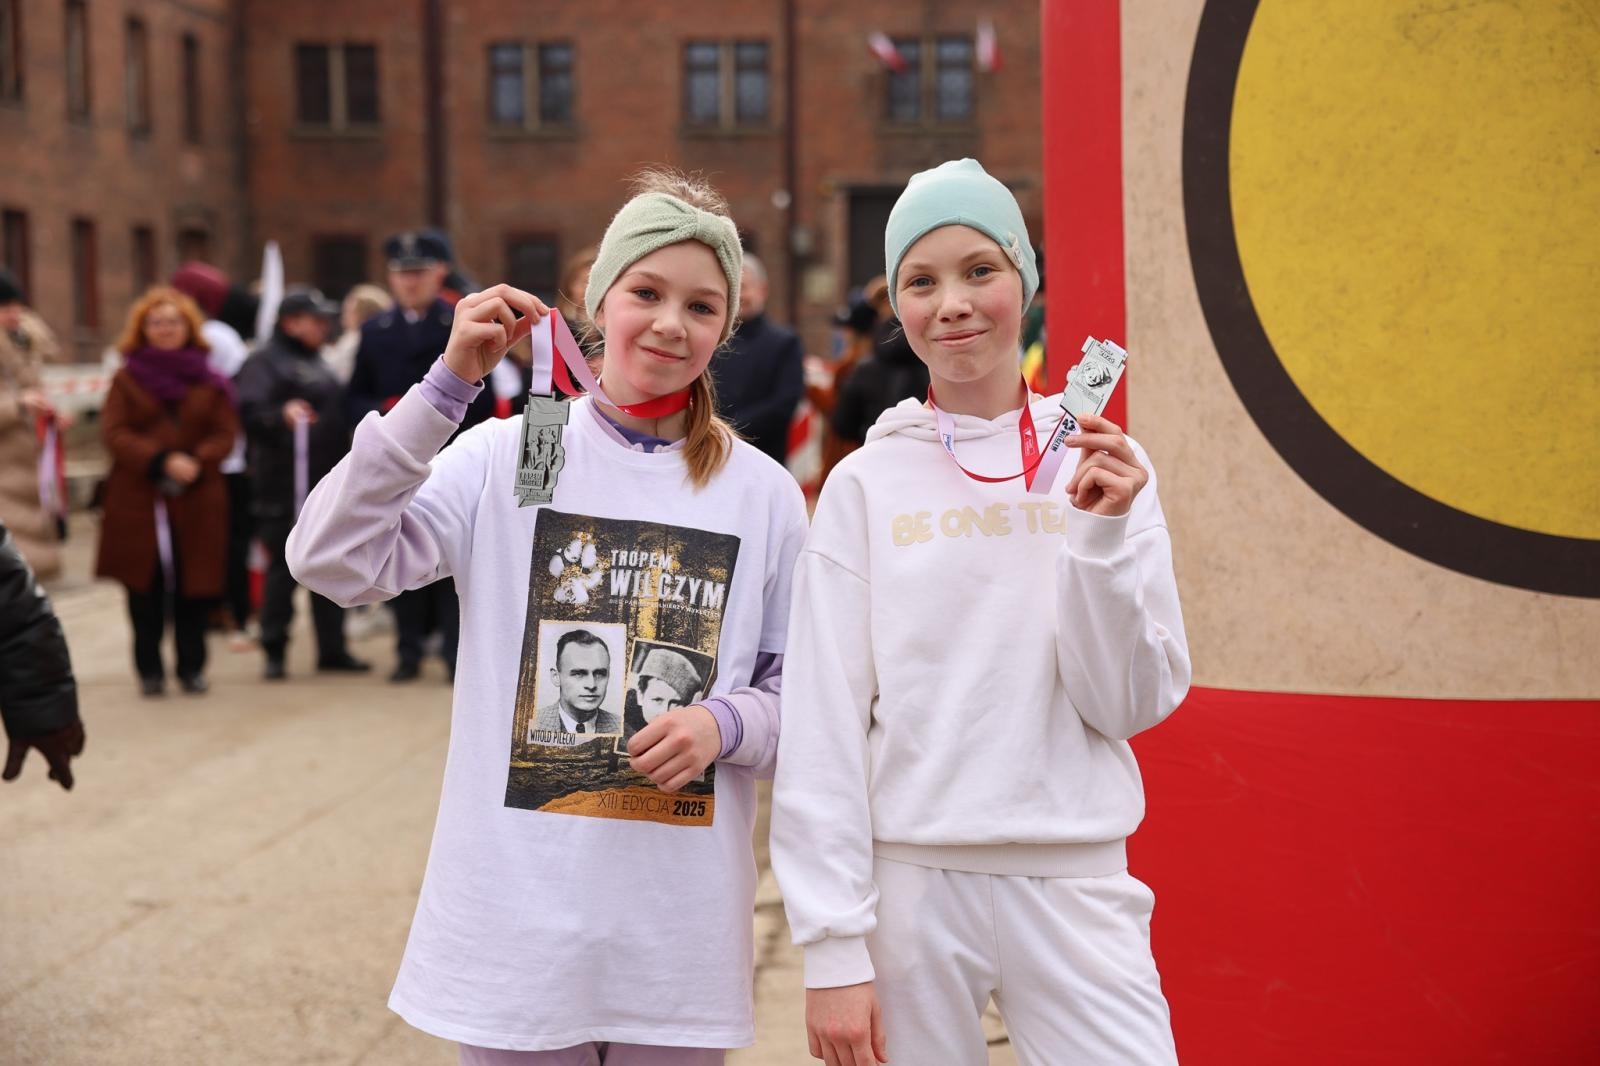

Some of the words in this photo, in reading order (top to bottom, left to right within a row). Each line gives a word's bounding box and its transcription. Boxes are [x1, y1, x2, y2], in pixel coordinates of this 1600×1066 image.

[891, 510, 934, 546] BE
[939, 502, 1013, 537] ONE
[611, 549, 673, 570] TROPEM
[611, 568, 726, 610] WILCZYM
[530, 729, 552, 743] WITOLD
[553, 731, 576, 745] PILECKI
[597, 792, 618, 809] XIII
[622, 794, 670, 816] EDYCJA
[672, 800, 707, 817] 2025
